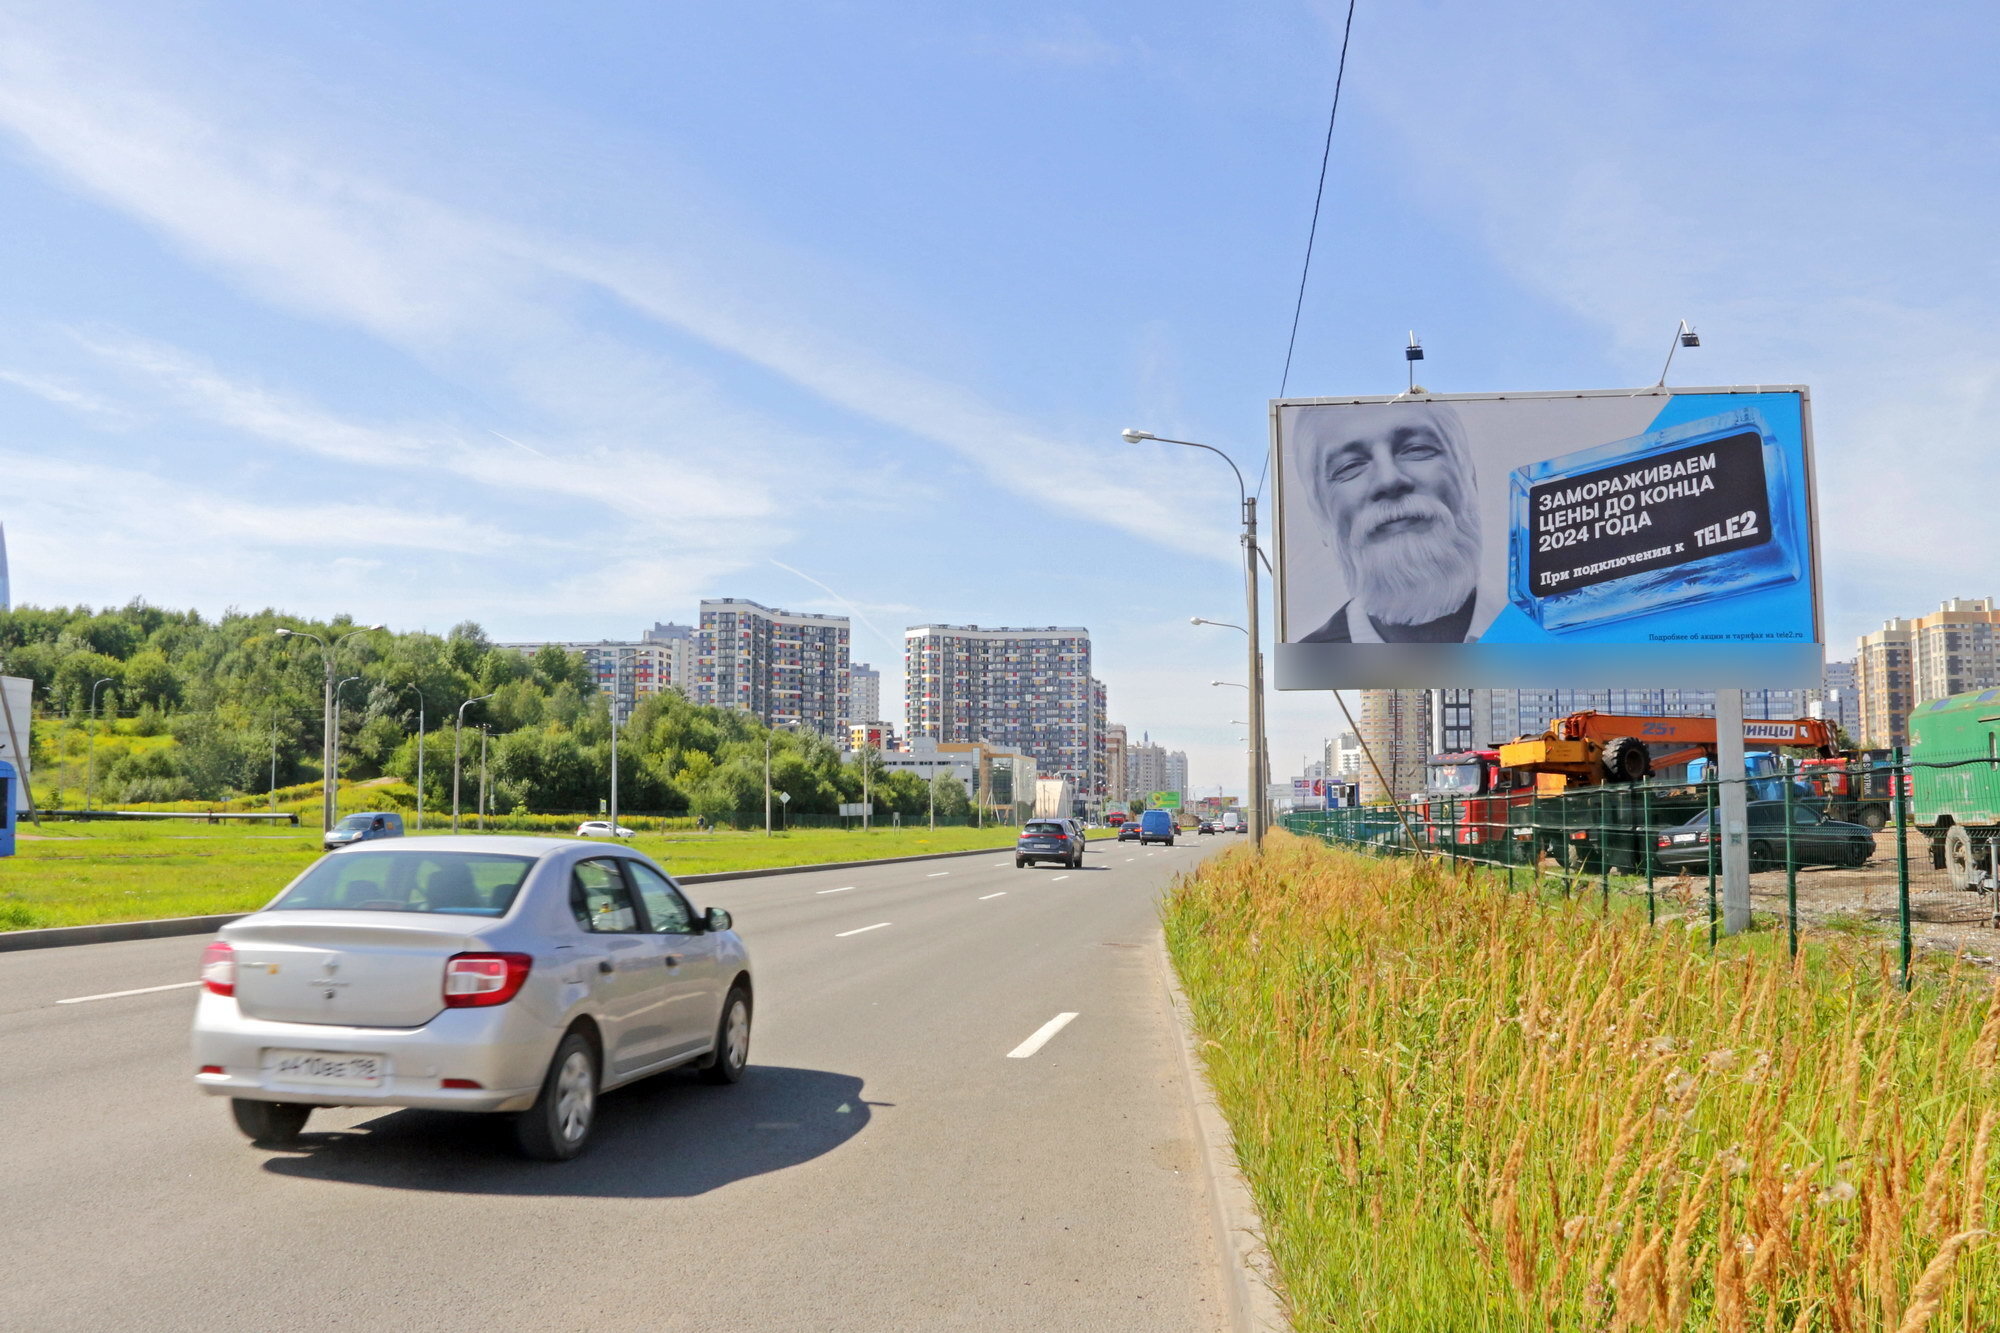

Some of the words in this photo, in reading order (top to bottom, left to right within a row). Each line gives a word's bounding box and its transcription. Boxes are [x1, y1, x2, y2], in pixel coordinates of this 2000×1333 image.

[1539, 452, 1716, 511] ЗАМОРАЖИВАЕМ
[1539, 502, 1599, 533] ЦЕНЫ
[1604, 494, 1635, 521] ДО
[1640, 474, 1715, 507] КОНЦА
[1539, 525, 1589, 552] 2024
[1594, 511, 1652, 539] ГОДА
[1540, 570, 1570, 586] При
[1573, 546, 1671, 578] подключении
[1675, 542, 1684, 552] к
[1694, 510, 1759, 547] TELE2
[1648, 633, 1688, 642] Подробнее
[1732, 632, 1763, 641] тарифах
